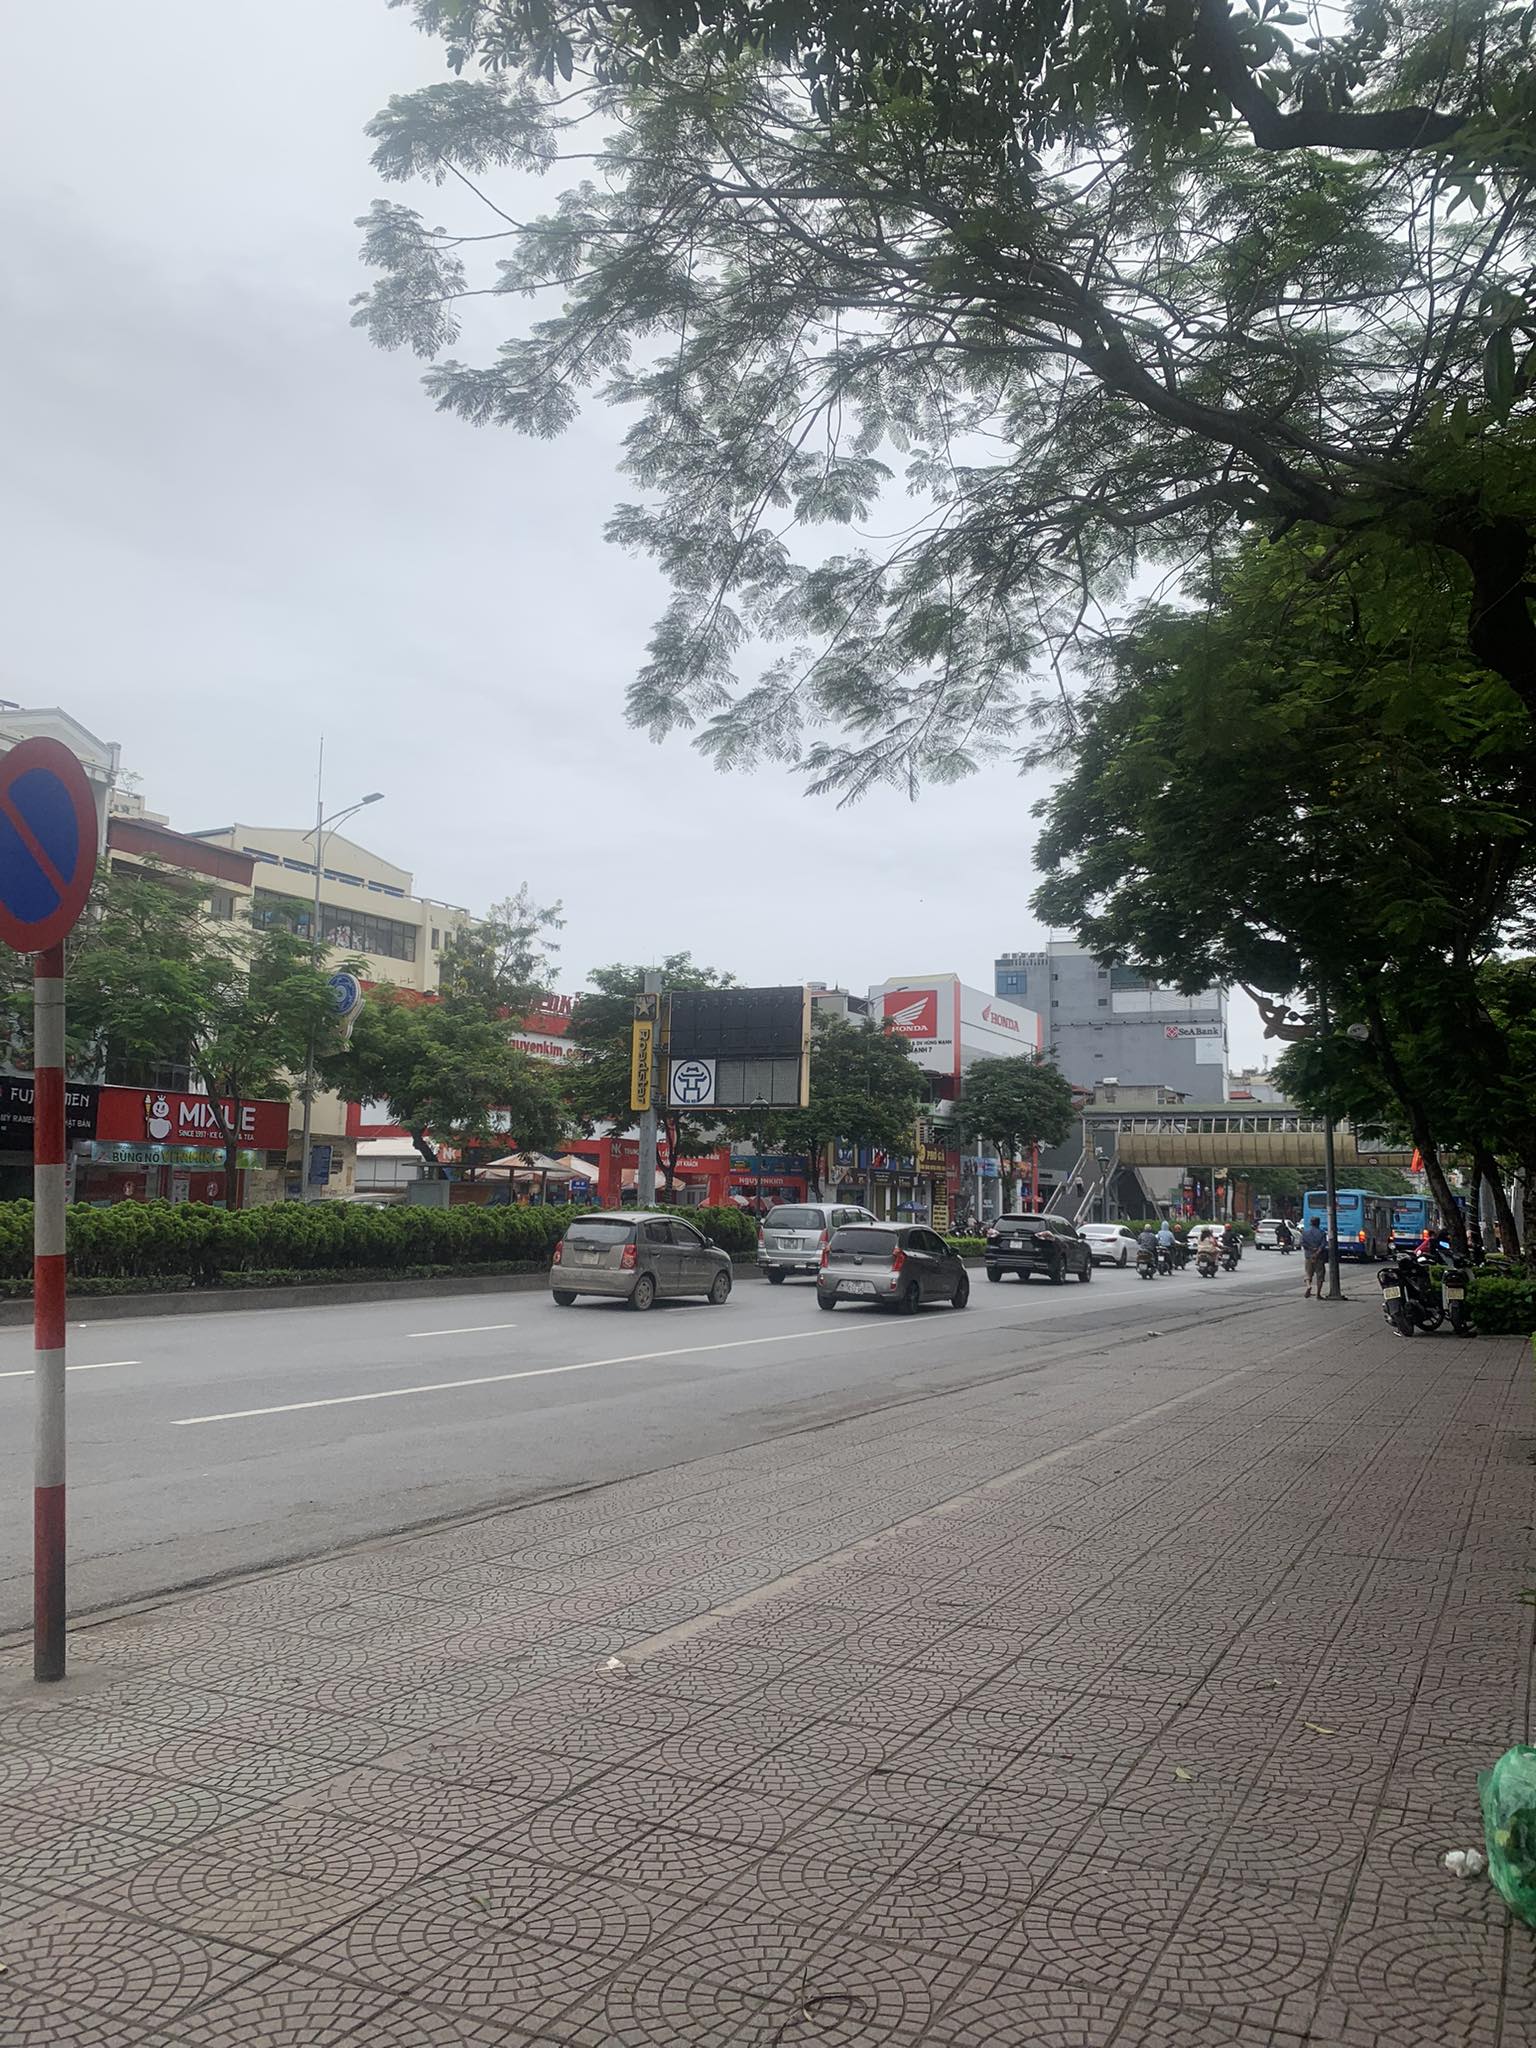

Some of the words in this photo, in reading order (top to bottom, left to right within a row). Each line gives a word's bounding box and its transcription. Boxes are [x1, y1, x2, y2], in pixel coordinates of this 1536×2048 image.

[990, 1012, 1020, 1032] HONDA
[891, 1025, 928, 1033] HONDA
[1178, 1027, 1218, 1036] SeABank
[637, 1029, 650, 1105] Roadstar
[178, 1130, 194, 1138] SINCE
[244, 1133, 255, 1141] TEA
[112, 1149, 142, 1163] BÙNG
